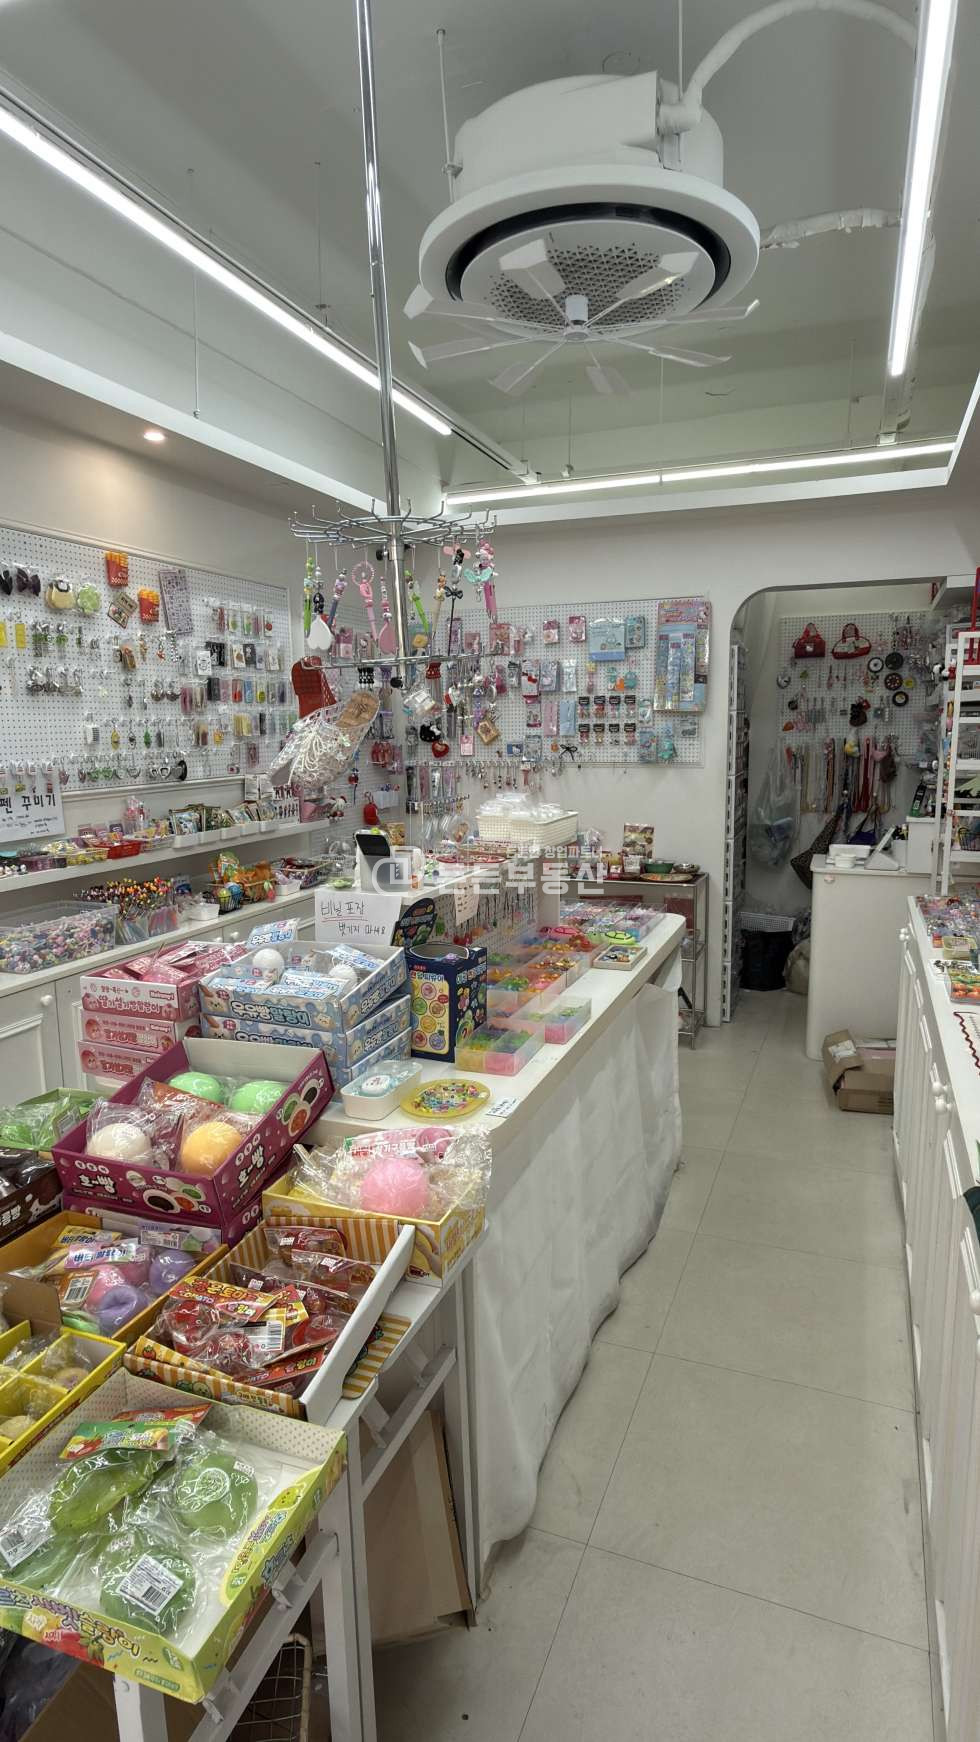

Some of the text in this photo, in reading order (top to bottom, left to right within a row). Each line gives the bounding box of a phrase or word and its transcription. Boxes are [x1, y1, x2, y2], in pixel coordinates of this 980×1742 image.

[22, 794, 56, 811] 꾸미기
[320, 900, 365, 916] 비닐 포장
[338, 922, 386, 936] 벗기지 마세요
